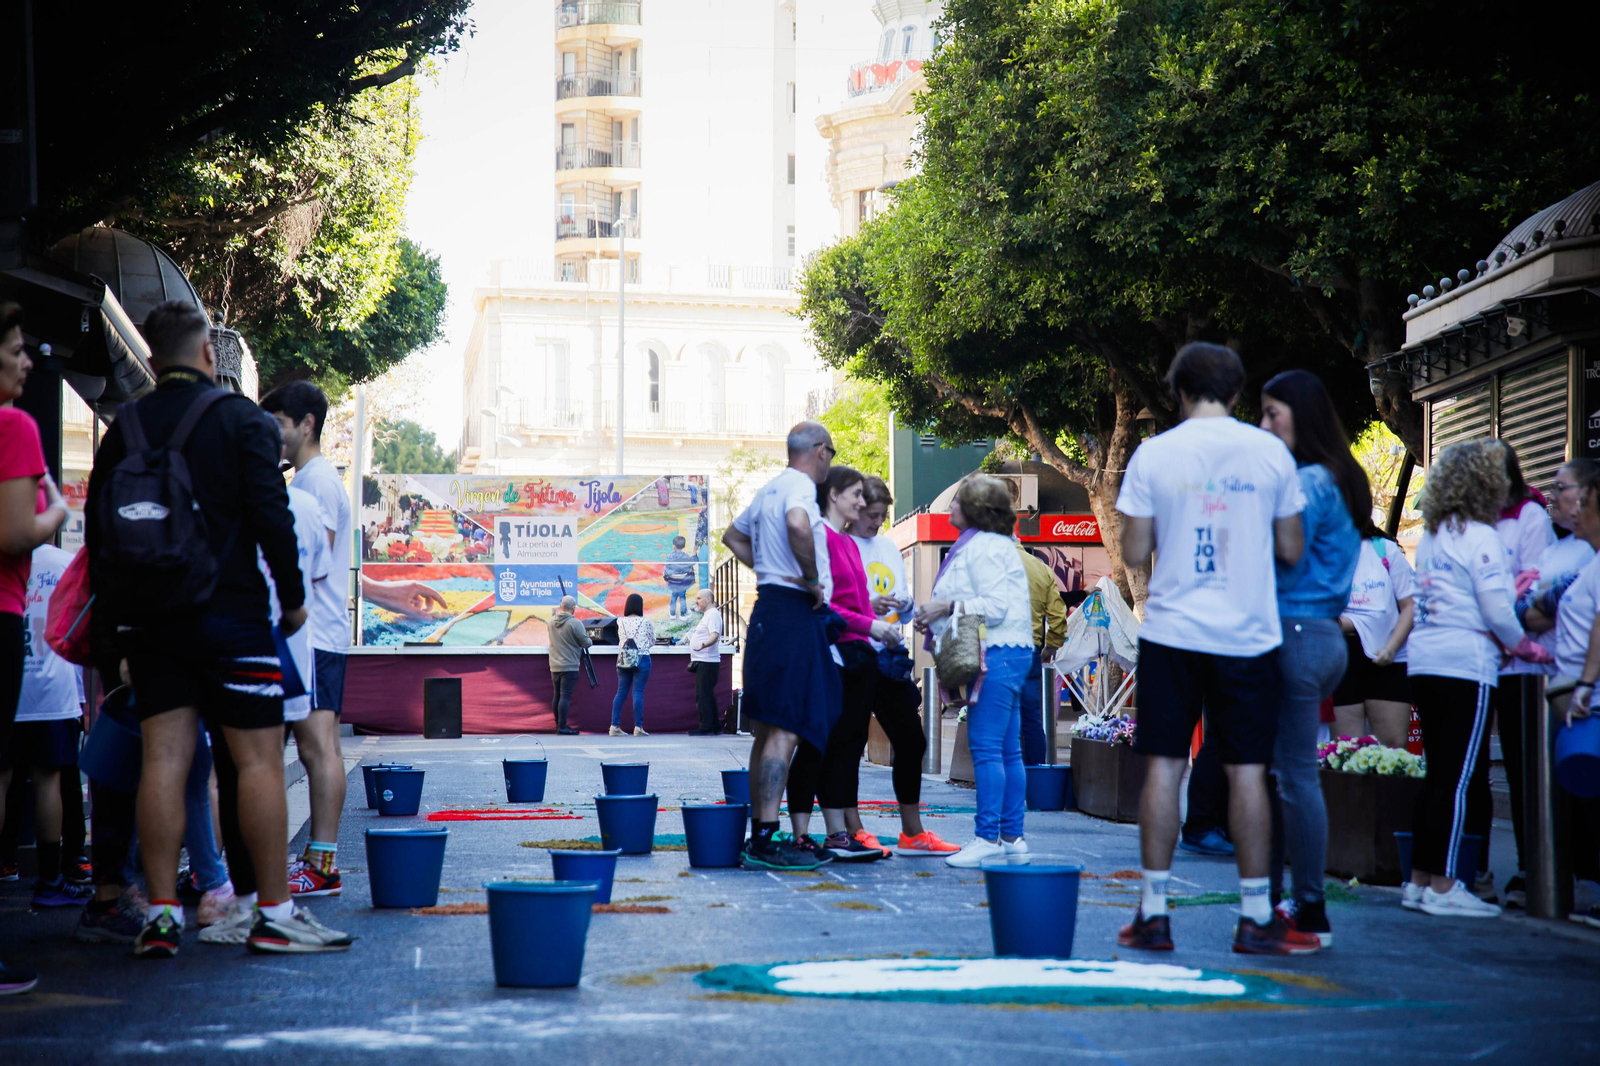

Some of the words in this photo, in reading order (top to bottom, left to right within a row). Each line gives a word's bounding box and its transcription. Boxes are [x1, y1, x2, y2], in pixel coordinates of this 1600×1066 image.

[450, 479, 501, 513] Virgen
[503, 482, 521, 504] de
[523, 478, 576, 509] Fátima
[579, 480, 622, 514] Tíjola
[514, 521, 573, 538] TÍJOLA
[1052, 520, 1098, 536] Coca-Cola
[517, 541, 527, 549] La
[529, 541, 549, 550] perla
[550, 541, 563, 549] del
[520, 588, 531, 596] de
